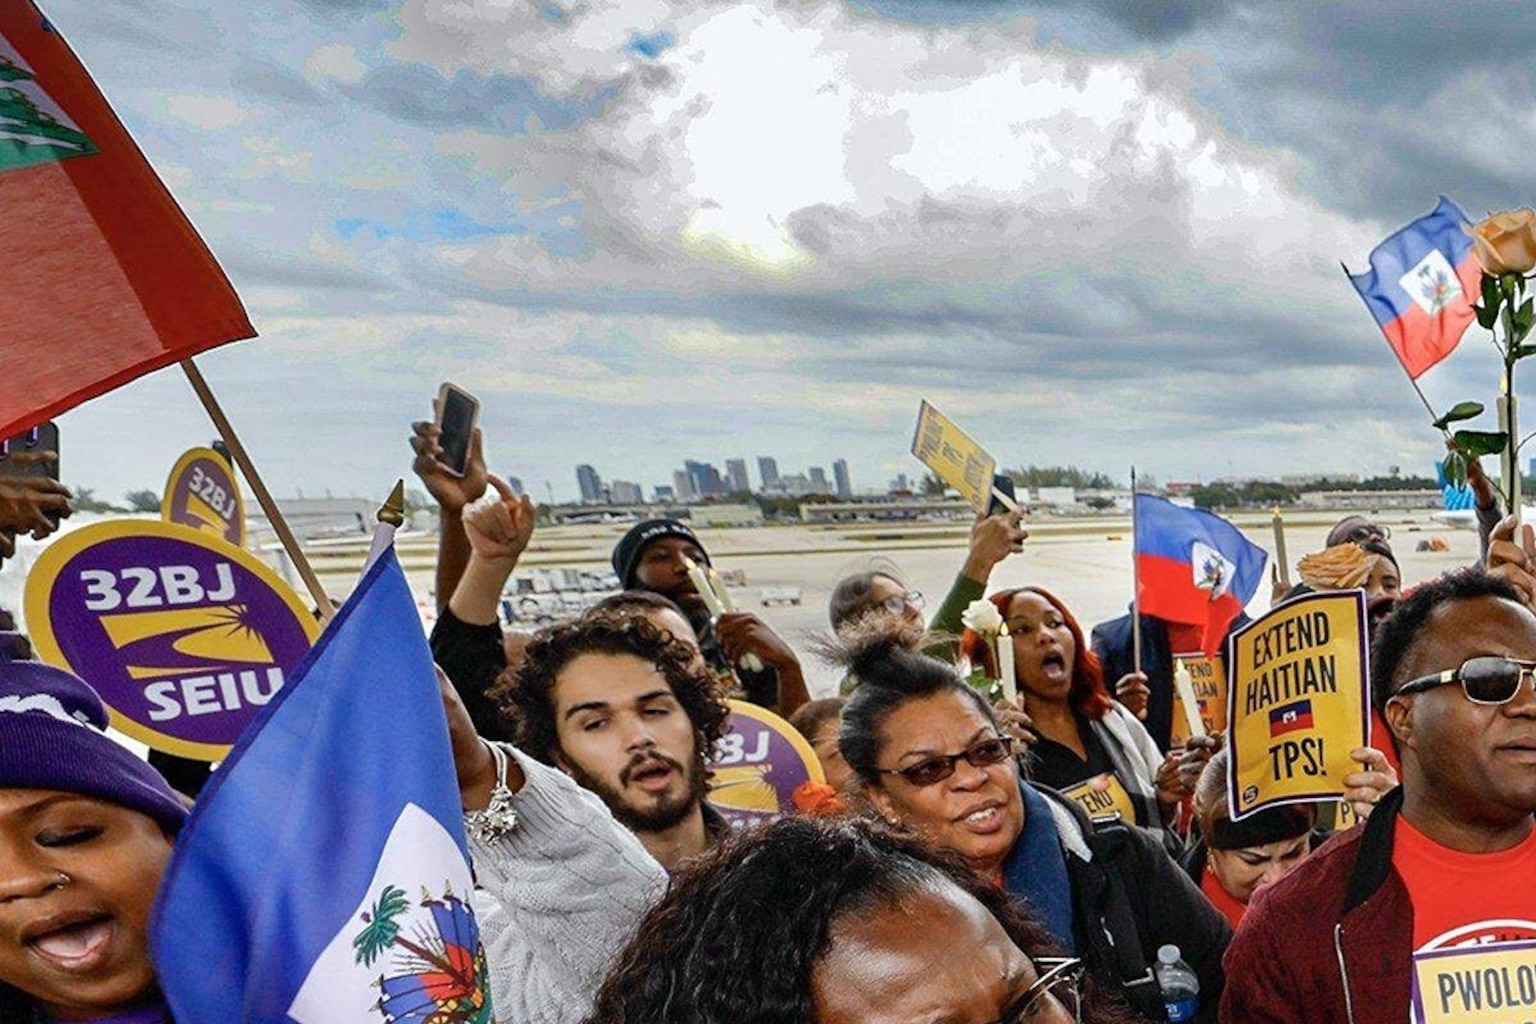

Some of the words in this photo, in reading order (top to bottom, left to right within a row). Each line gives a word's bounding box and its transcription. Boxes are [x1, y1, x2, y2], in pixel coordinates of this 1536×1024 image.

[188, 467, 235, 520] 32BJ
[80, 563, 237, 611] 32BJ
[1253, 612, 1330, 670] EXTEND
[144, 667, 285, 721] SEIU
[1245, 655, 1337, 716] HAITIAN
[714, 731, 770, 764] BJ
[1268, 738, 1327, 782] TPS!
